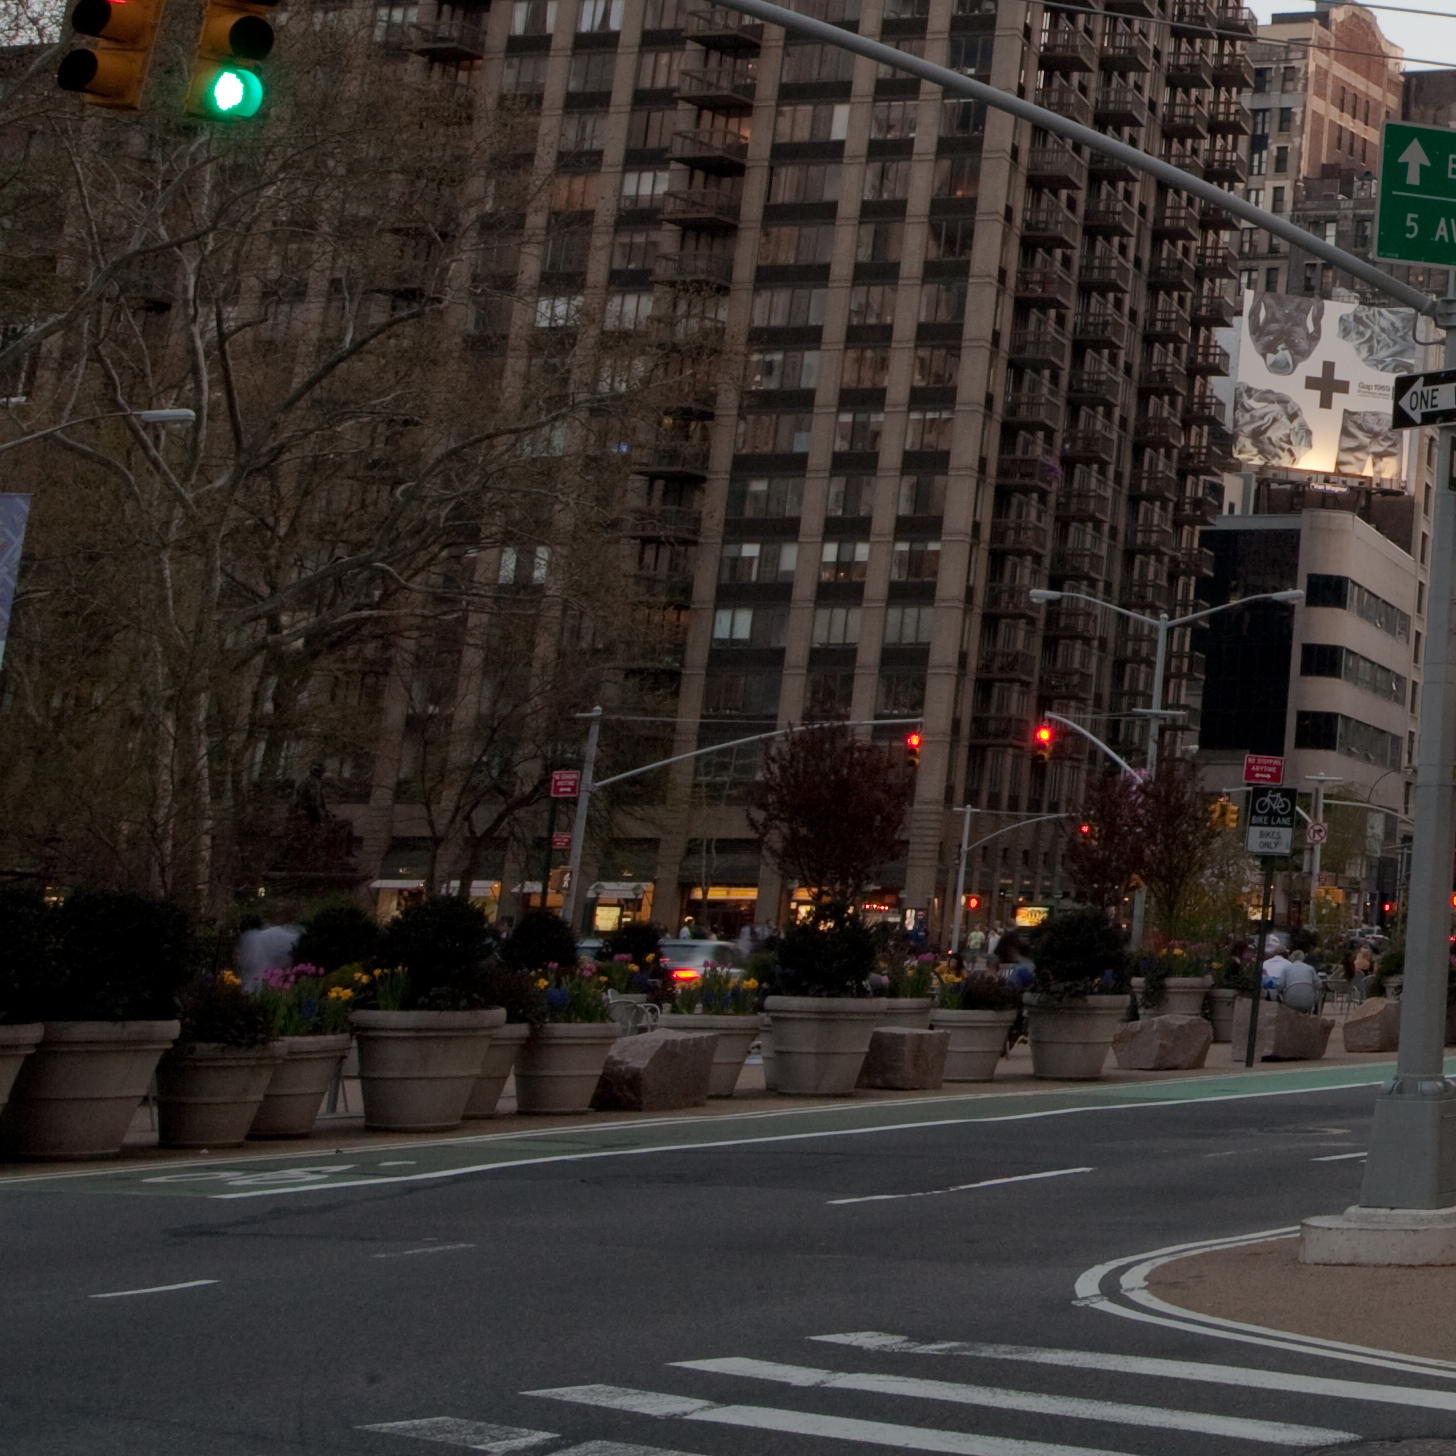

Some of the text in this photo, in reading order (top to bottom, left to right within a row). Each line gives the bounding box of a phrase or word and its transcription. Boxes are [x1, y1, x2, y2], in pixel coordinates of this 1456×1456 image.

[1405, 213, 1419, 239] 5
[1409, 388, 1439, 411] ONE
[1251, 815, 1292, 826] BIKE LANE
[1258, 830, 1282, 839] BIKES
[1258, 840, 1280, 850] ONLY
